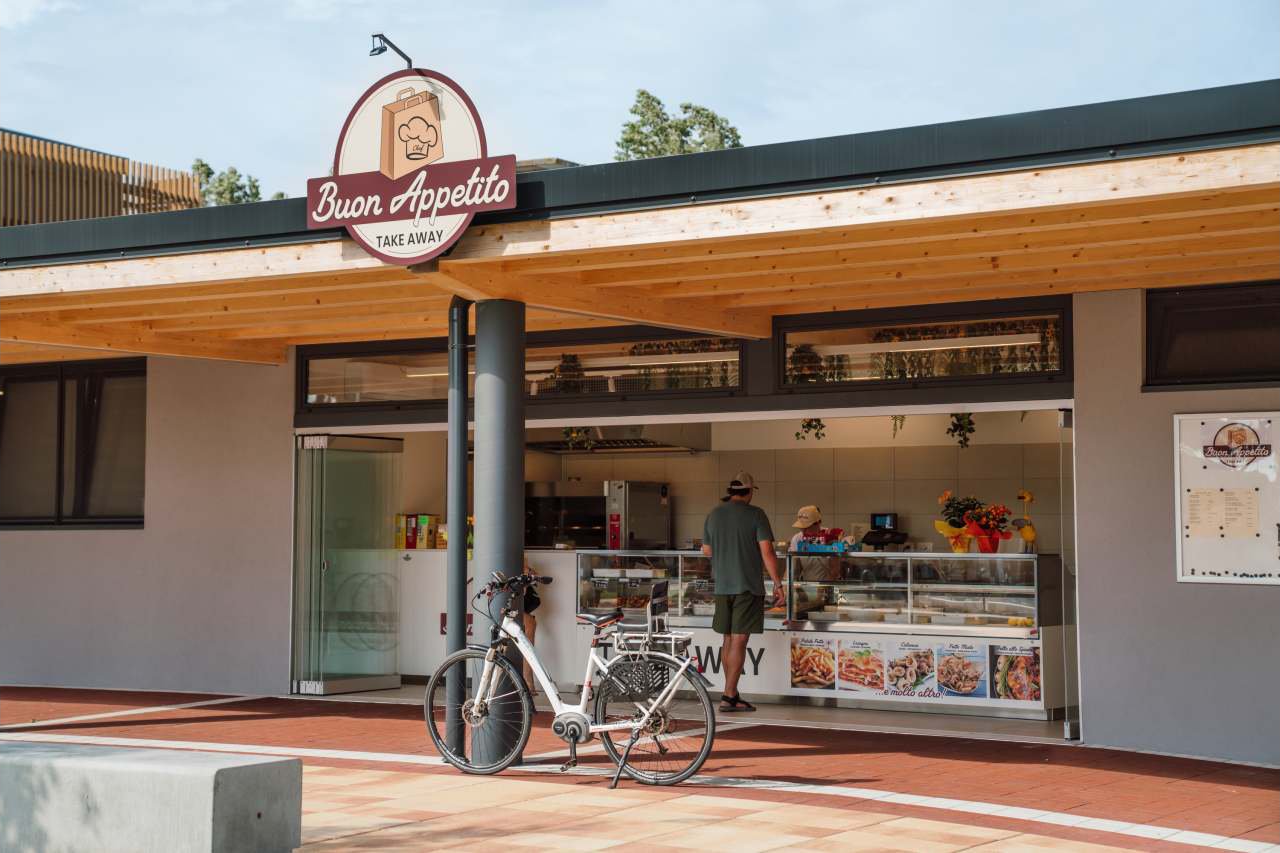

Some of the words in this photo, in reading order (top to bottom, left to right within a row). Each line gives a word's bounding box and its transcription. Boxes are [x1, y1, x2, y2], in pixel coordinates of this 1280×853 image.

[312, 181, 383, 223] Buon
[389, 164, 510, 227] Appetito
[376, 233, 405, 248] TAKE
[407, 230, 444, 246] AWAY
[686, 645, 765, 676] WY
[890, 686, 916, 697] molto
